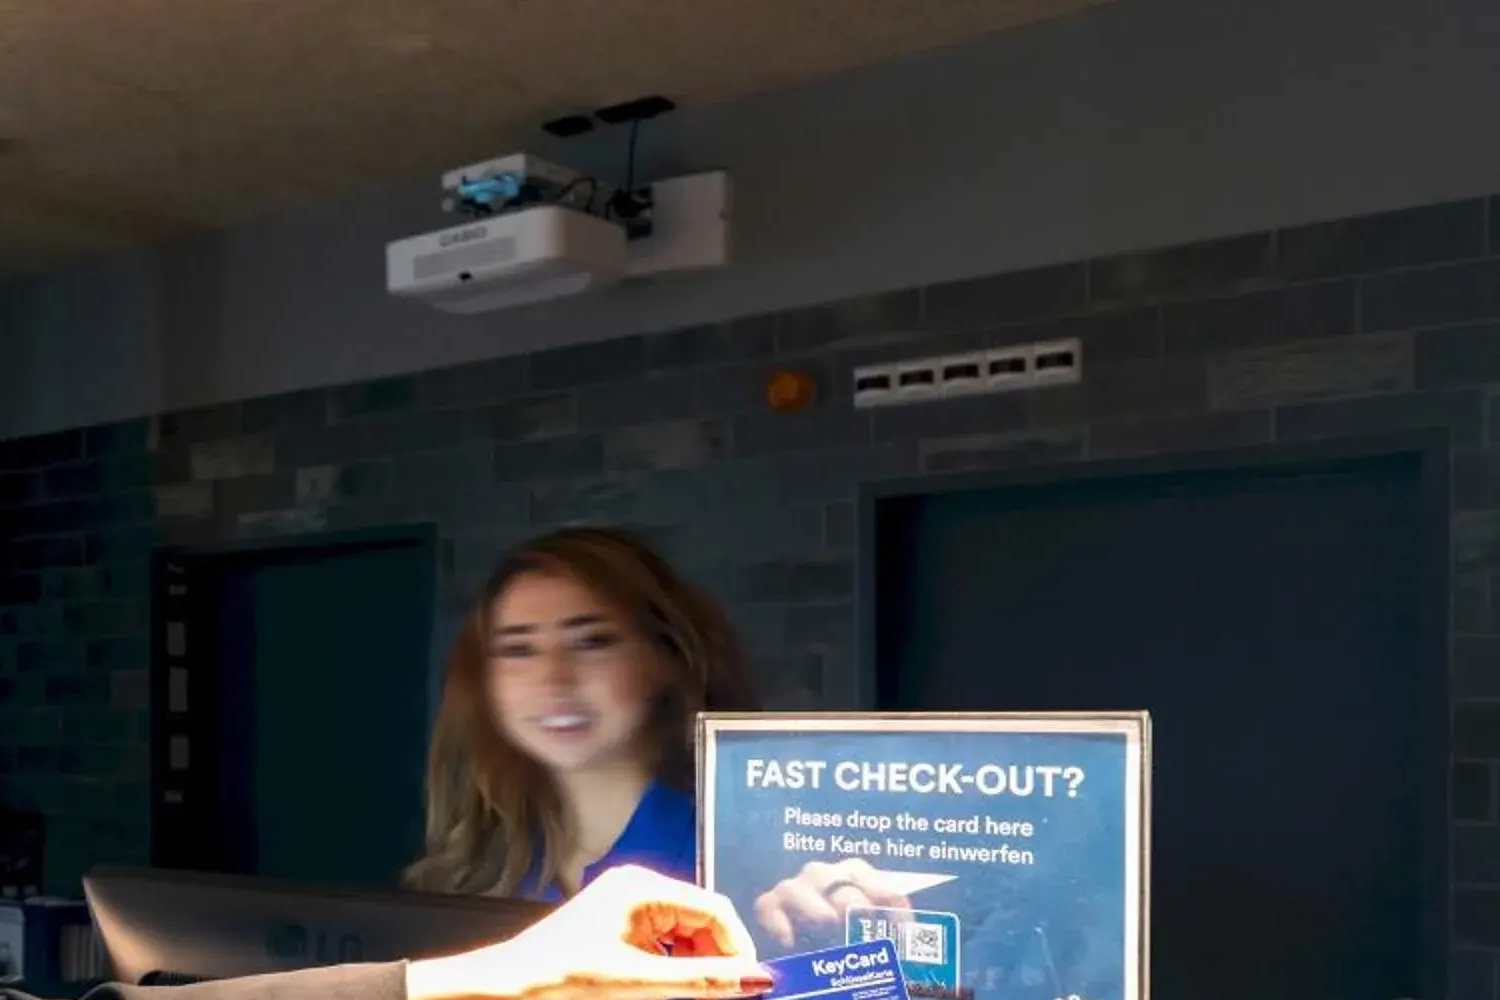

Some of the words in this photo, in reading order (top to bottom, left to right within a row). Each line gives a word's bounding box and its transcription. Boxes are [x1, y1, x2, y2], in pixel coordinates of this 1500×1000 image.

[746, 759, 827, 789] FAST
[834, 761, 1085, 798] CHECK-OUT?
[784, 806, 842, 828] Please
[846, 809, 891, 832] drop
[895, 812, 929, 831] the
[933, 815, 979, 834] card
[985, 816, 1033, 837] here
[783, 832, 825, 852] Bitte
[831, 835, 881, 855] Karte
[887, 838, 924, 857] hier
[929, 841, 1033, 865] einwerfen
[812, 947, 889, 977] KeyCard
